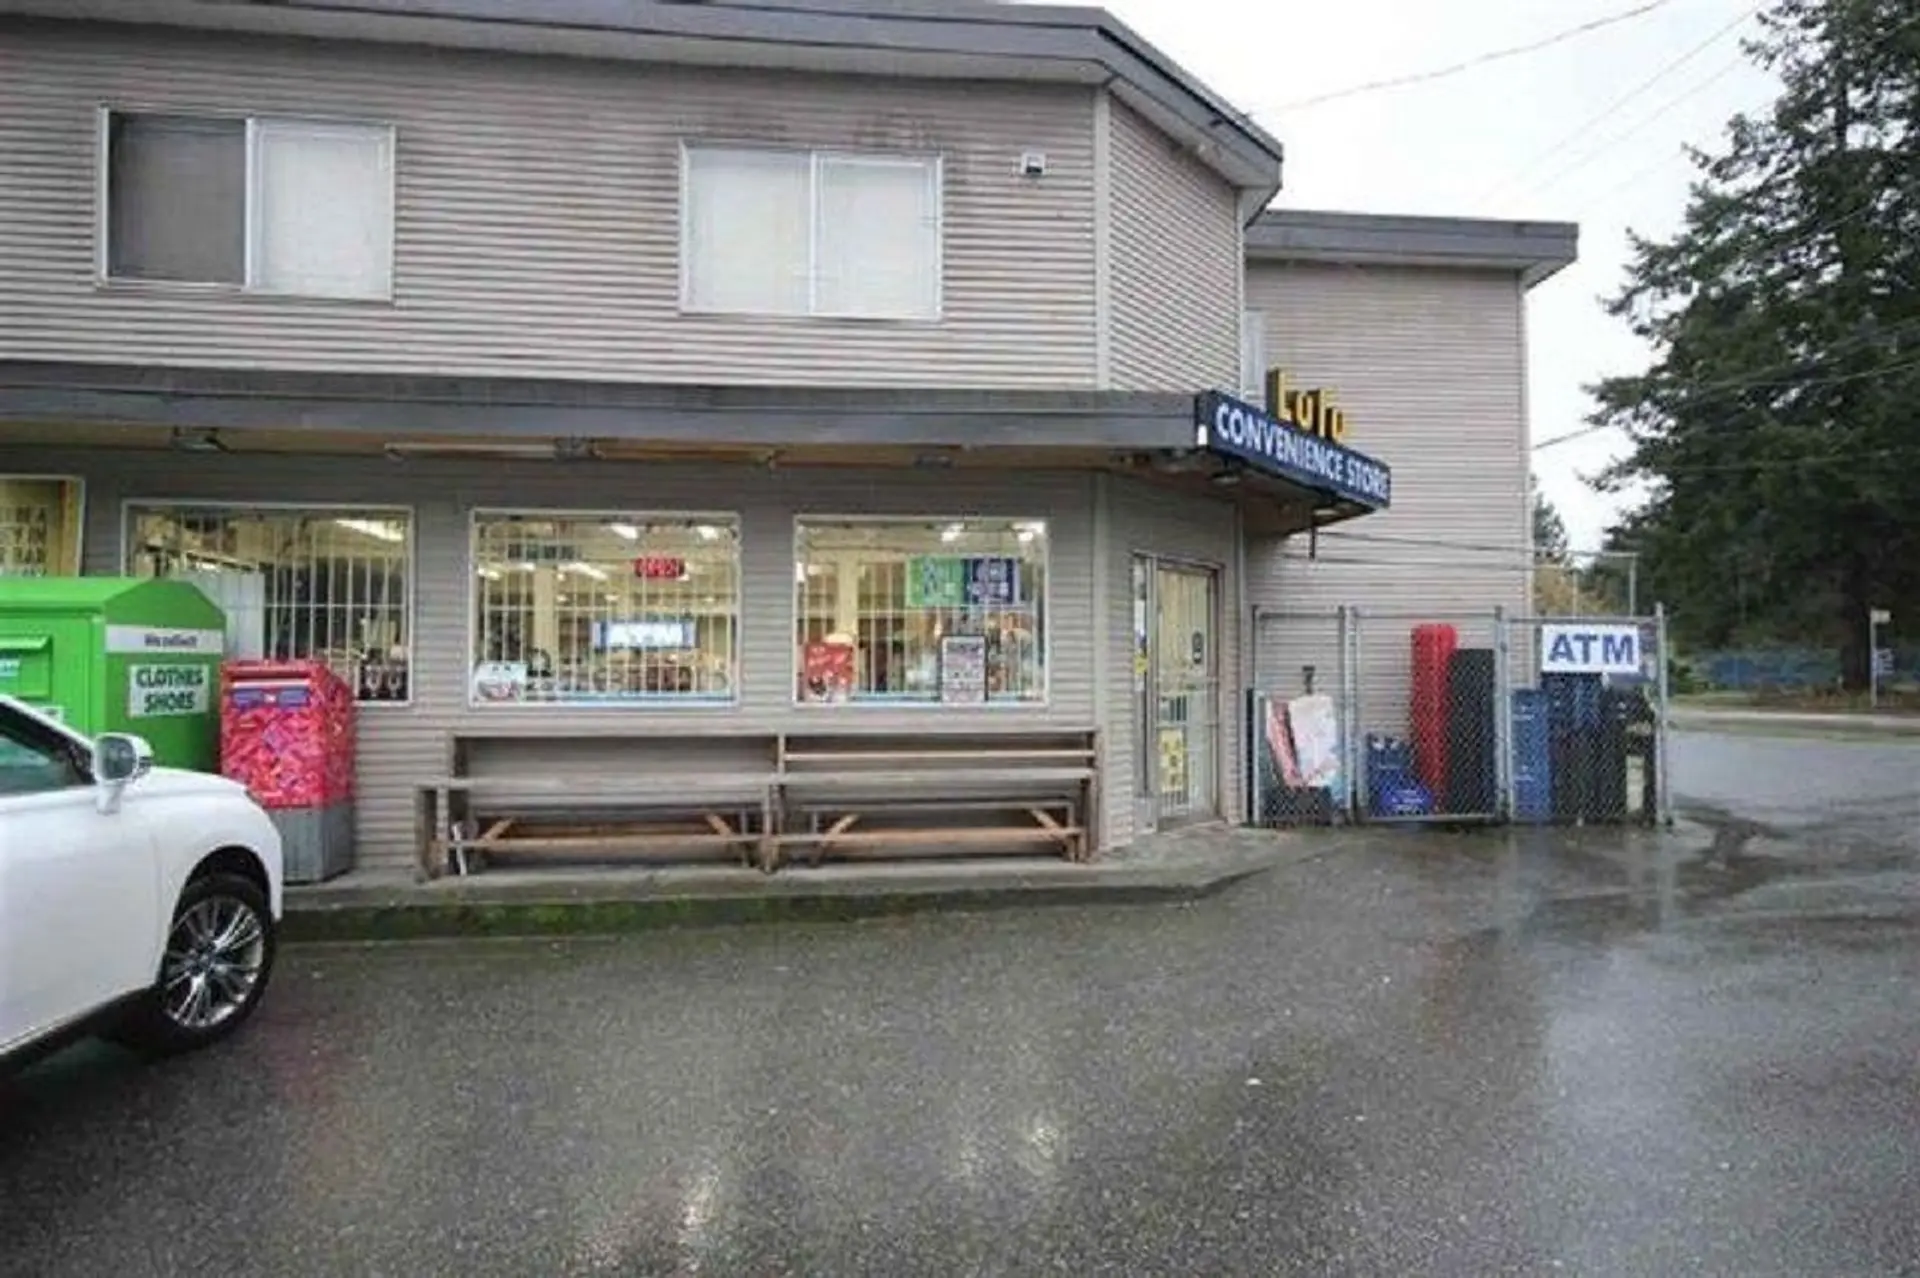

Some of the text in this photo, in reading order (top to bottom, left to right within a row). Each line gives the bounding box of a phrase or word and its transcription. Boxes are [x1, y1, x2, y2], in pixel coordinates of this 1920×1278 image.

[1215, 402, 1389, 500] CONVENIENCE STORE
[1548, 633, 1634, 664] ATM
[136, 667, 203, 687] CLOTHES
[144, 690, 194, 713] SHOES
